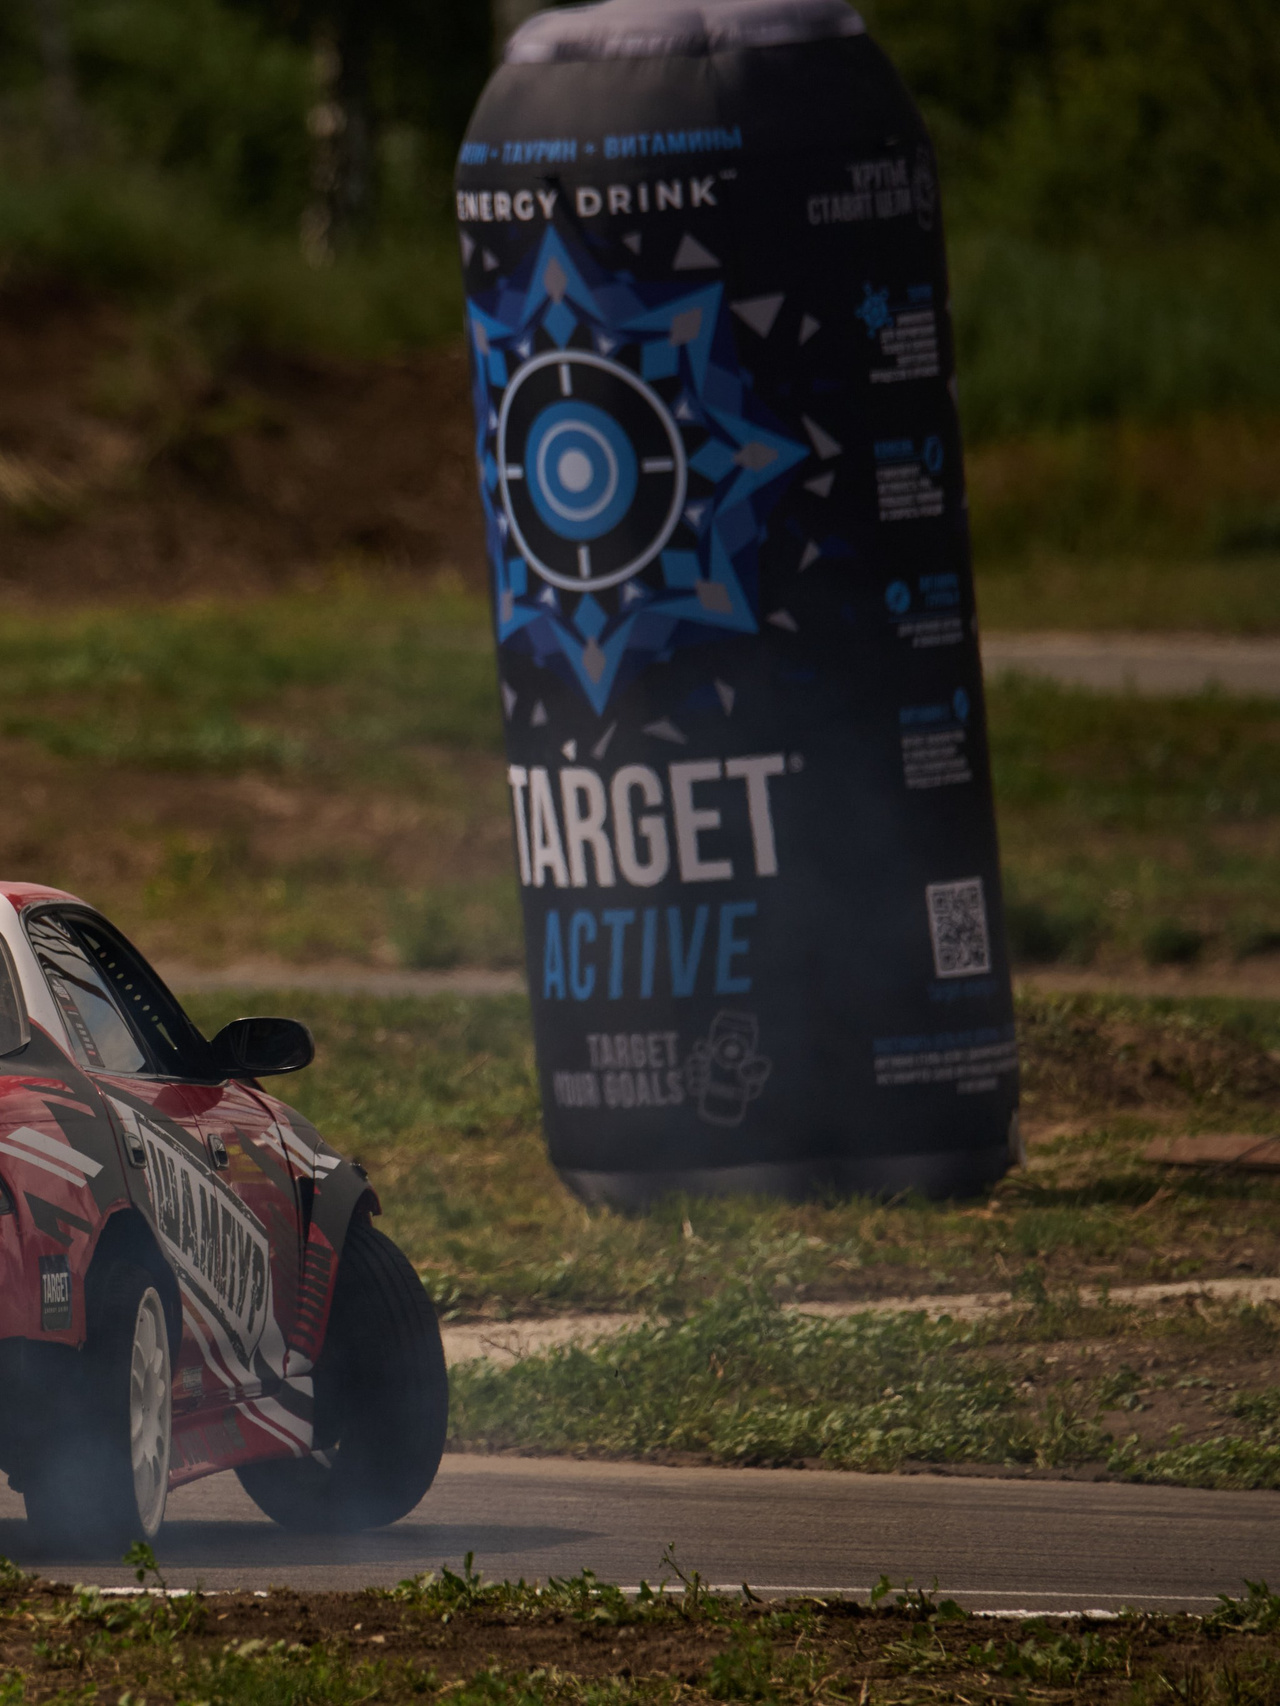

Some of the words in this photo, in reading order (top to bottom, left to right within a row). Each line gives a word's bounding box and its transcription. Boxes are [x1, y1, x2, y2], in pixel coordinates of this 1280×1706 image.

[603, 126, 743, 160] ВИТАМИНЫ
[456, 189, 558, 222] ENERGY
[575, 174, 718, 217] DRINK
[508, 753, 785, 888] TARGET
[543, 900, 758, 1001] ACTIVE
[586, 1031, 679, 1069] TARGET
[42, 1272, 68, 1303] TARGET
